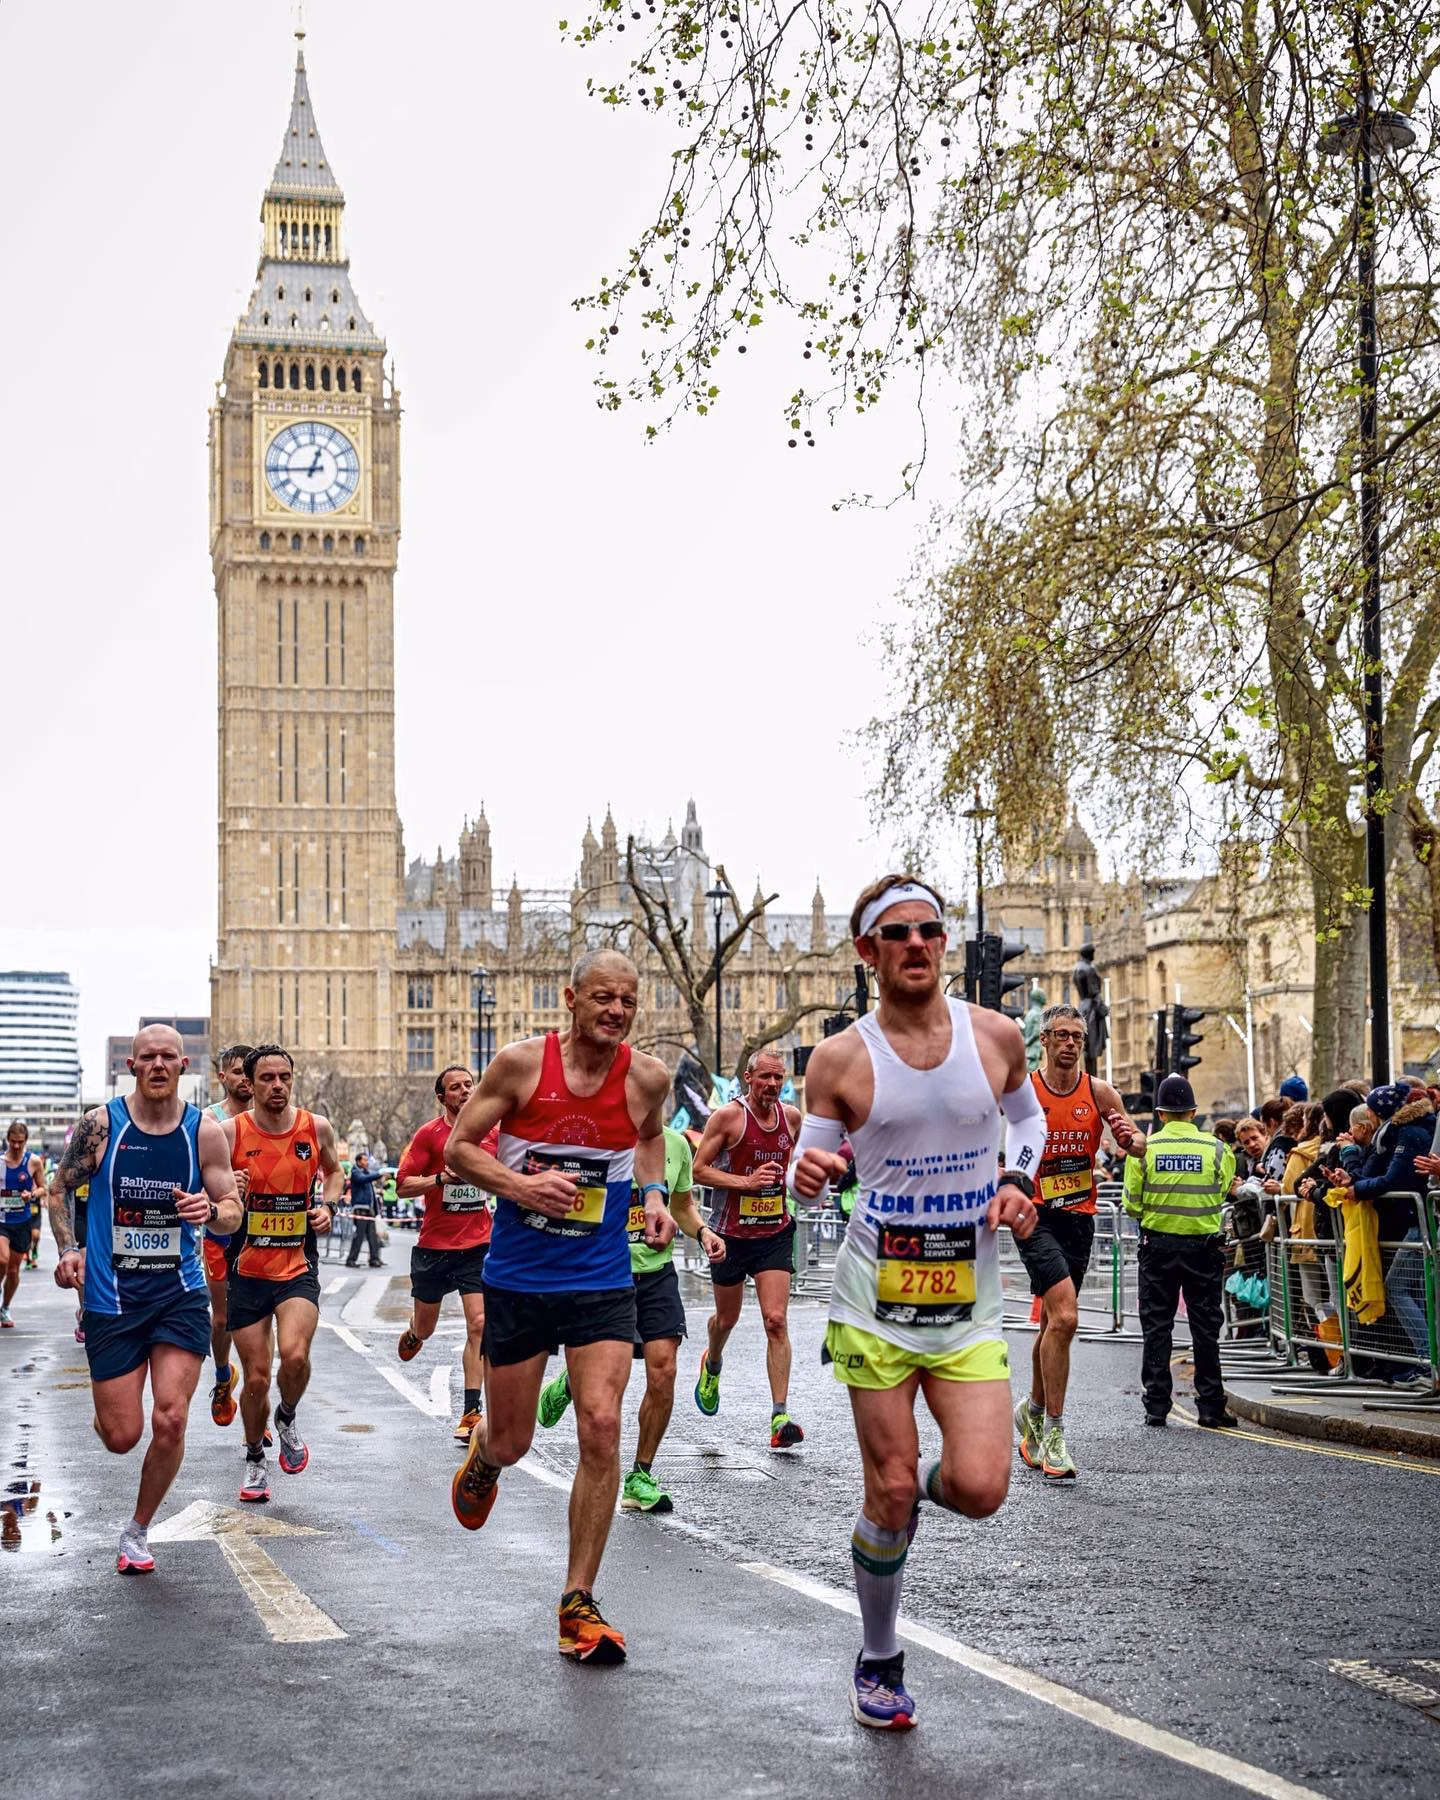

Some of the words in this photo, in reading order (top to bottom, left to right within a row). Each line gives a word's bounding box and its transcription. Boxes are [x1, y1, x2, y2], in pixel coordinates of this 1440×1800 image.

[1047, 1131, 1090, 1140] ESTERN
[754, 1150, 783, 1161] Ripon
[1157, 1160, 1201, 1171] POLICE
[120, 1177, 182, 1190] Ballymena
[751, 1201, 775, 1212] 5662
[868, 1191, 914, 1213] LDN
[118, 1207, 143, 1225] tcs
[261, 1217, 295, 1232] 4113
[545, 1226, 561, 1235] new
[124, 1233, 170, 1249] 30698
[884, 1231, 921, 1256] tcs
[923, 1240, 971, 1249] CONSULTANCY
[923, 1249, 956, 1257] SERVICES
[901, 1269, 957, 1294] 2782
[917, 1315, 934, 1323] new
